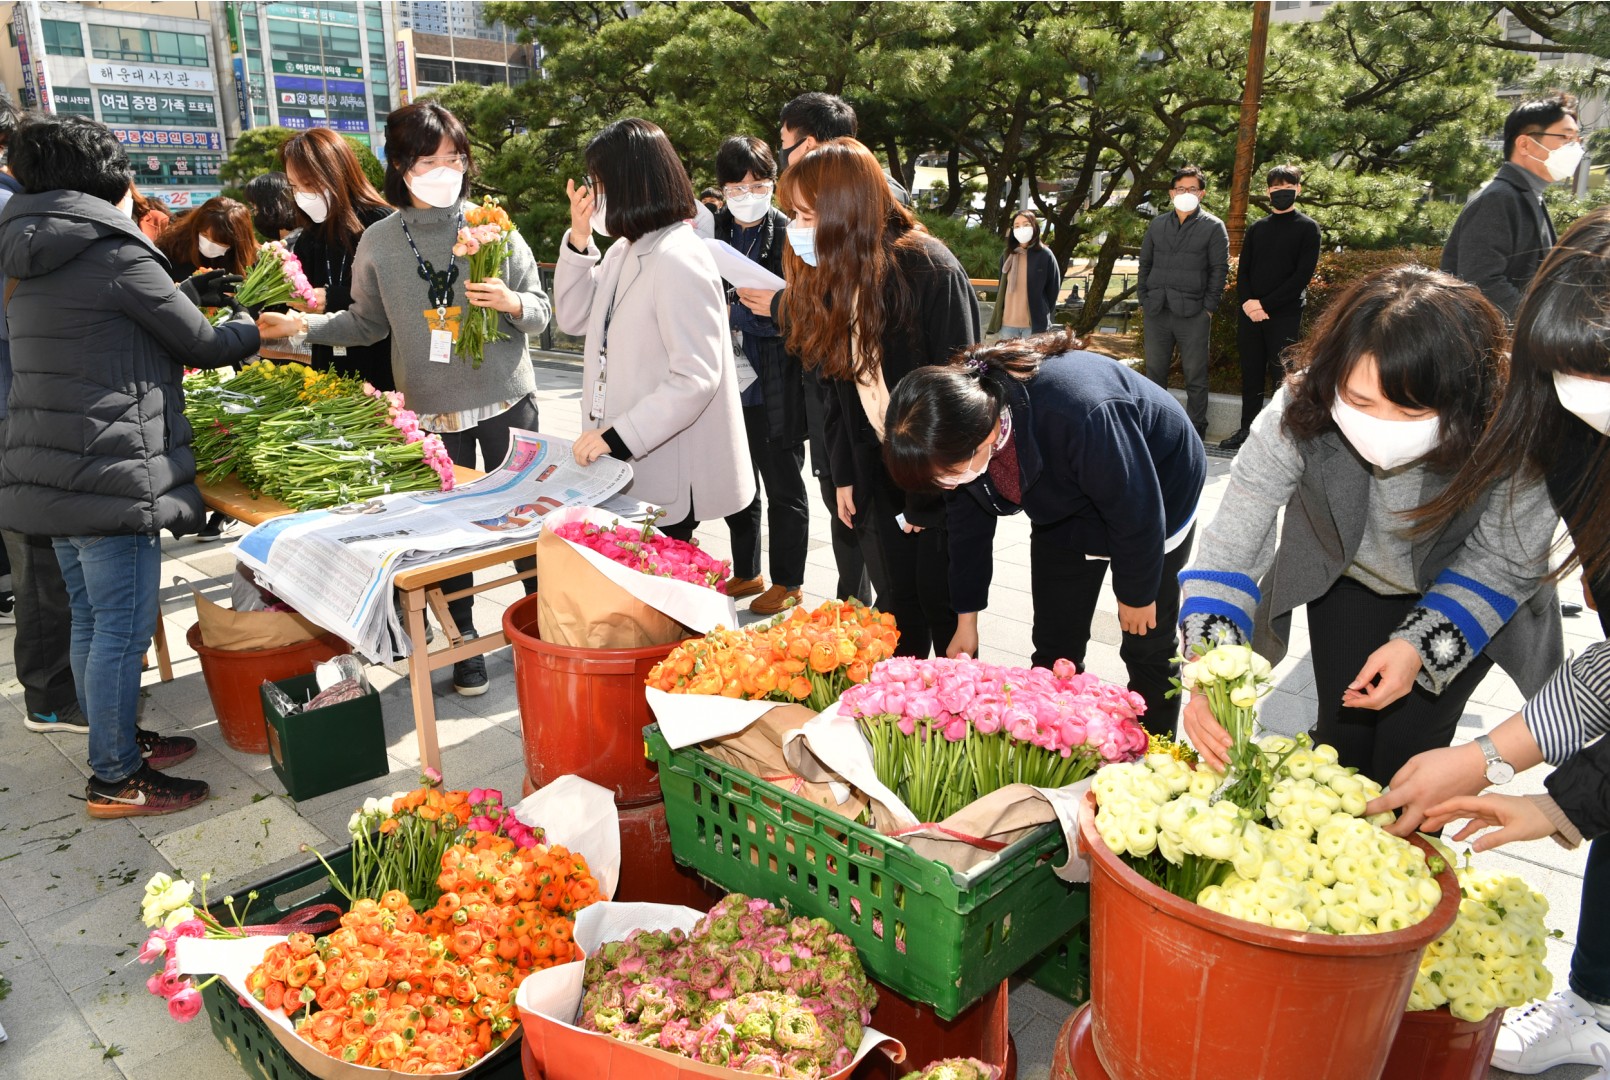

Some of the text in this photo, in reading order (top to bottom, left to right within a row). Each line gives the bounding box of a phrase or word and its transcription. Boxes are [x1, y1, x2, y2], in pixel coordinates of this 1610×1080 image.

[70, 96, 91, 105] 사진관
[101, 93, 214, 113] 여권 증명 가족 프로필
[236, 80, 246, 120] 우리은행
[340, 94, 365, 110] 사무소
